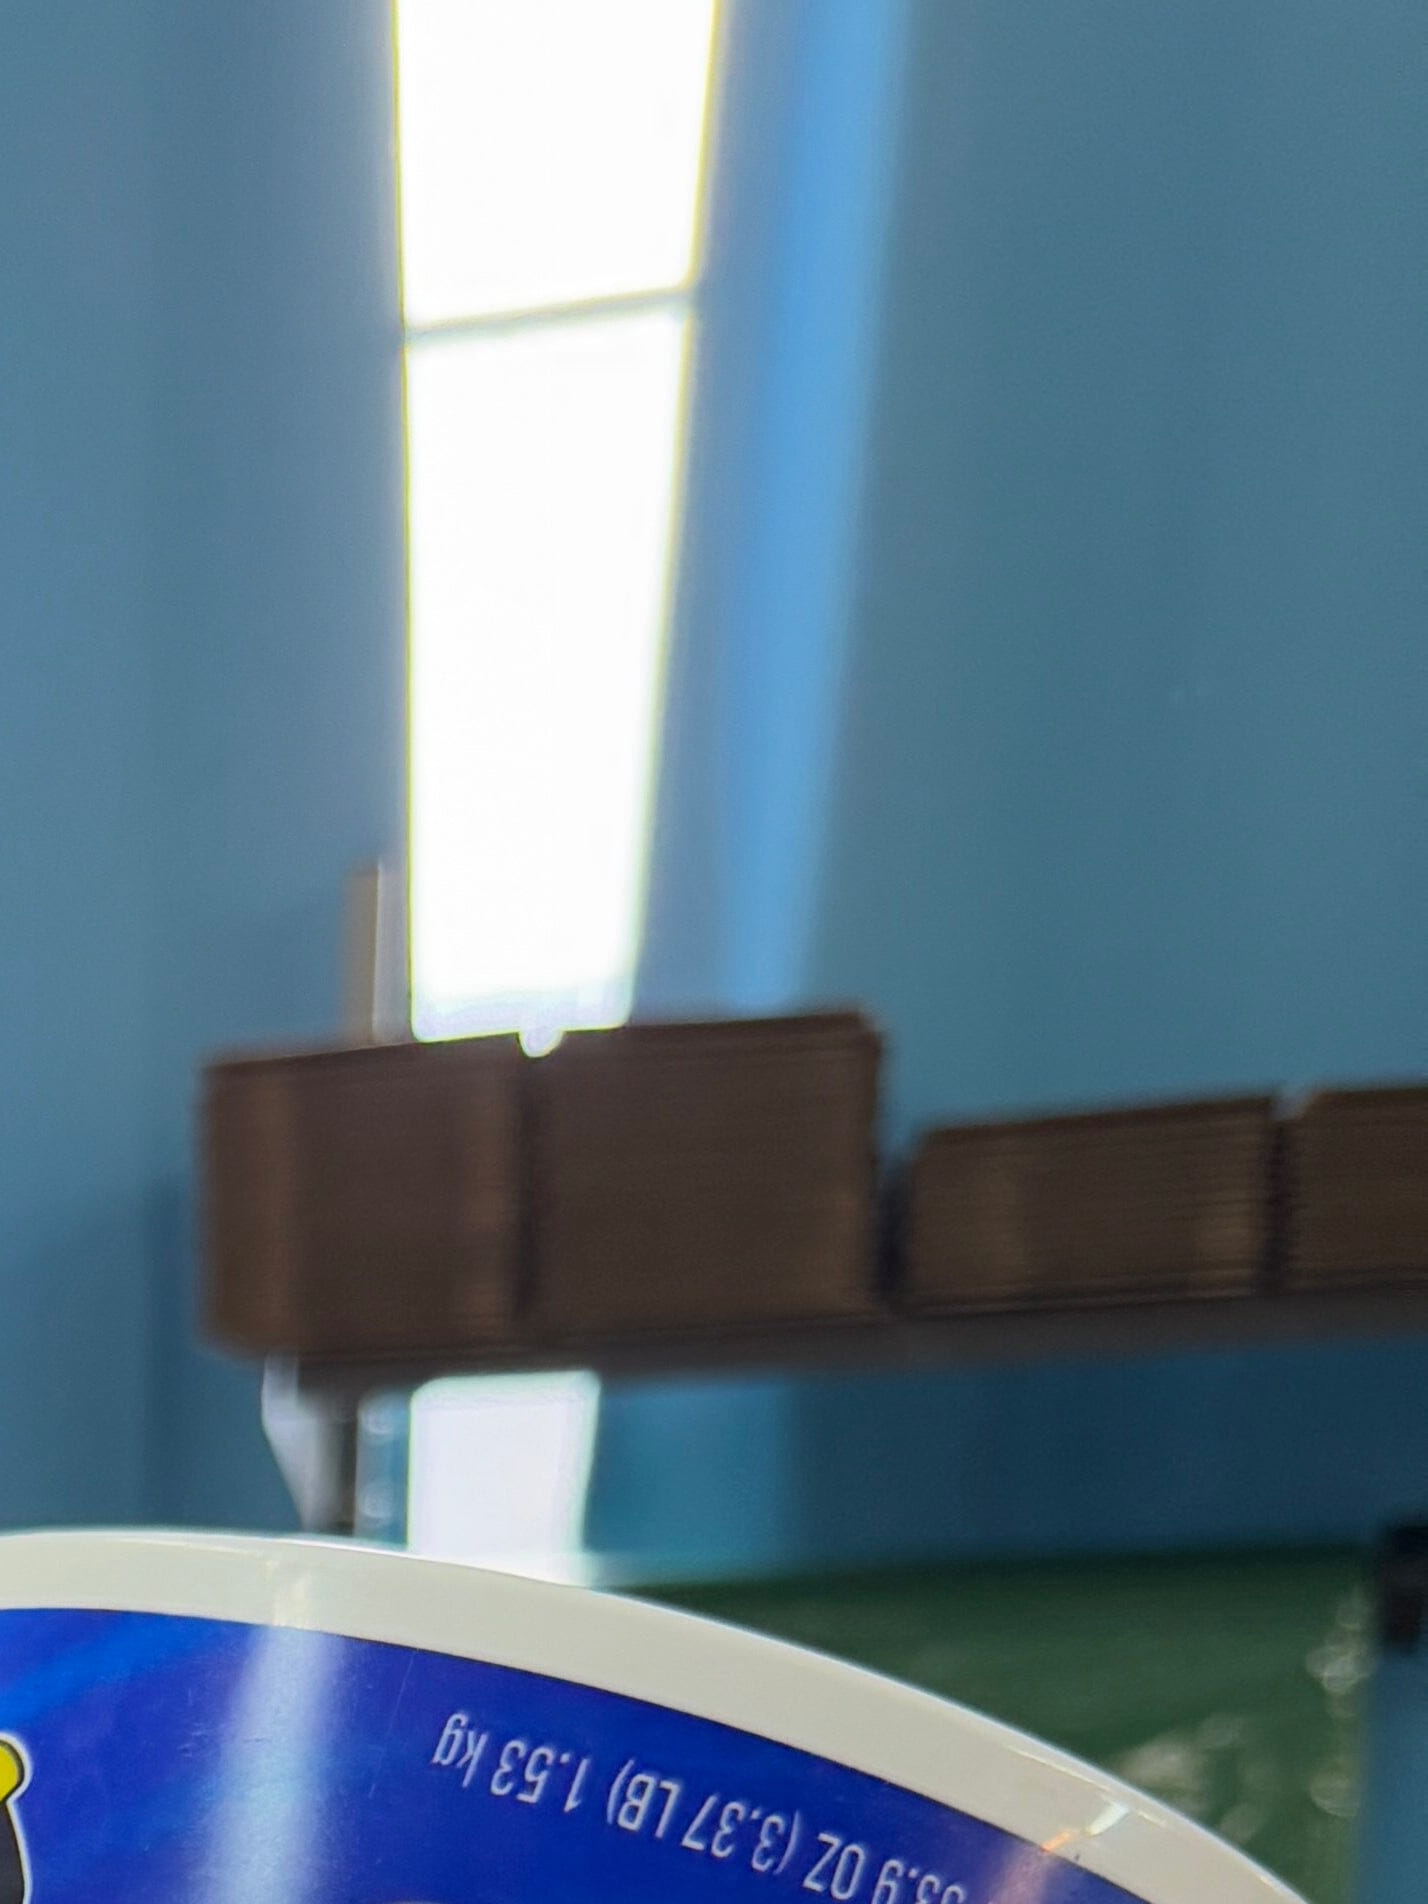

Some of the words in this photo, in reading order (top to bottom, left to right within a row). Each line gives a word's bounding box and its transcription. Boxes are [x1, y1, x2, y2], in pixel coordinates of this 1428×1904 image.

[429, 1711, 484, 1789] kg
[490, 1737, 592, 1814] 1.53
[607, 1758, 677, 1842] LB)
[681, 1793, 802, 1878] (3.37
[804, 1832, 868, 1901] OZ
